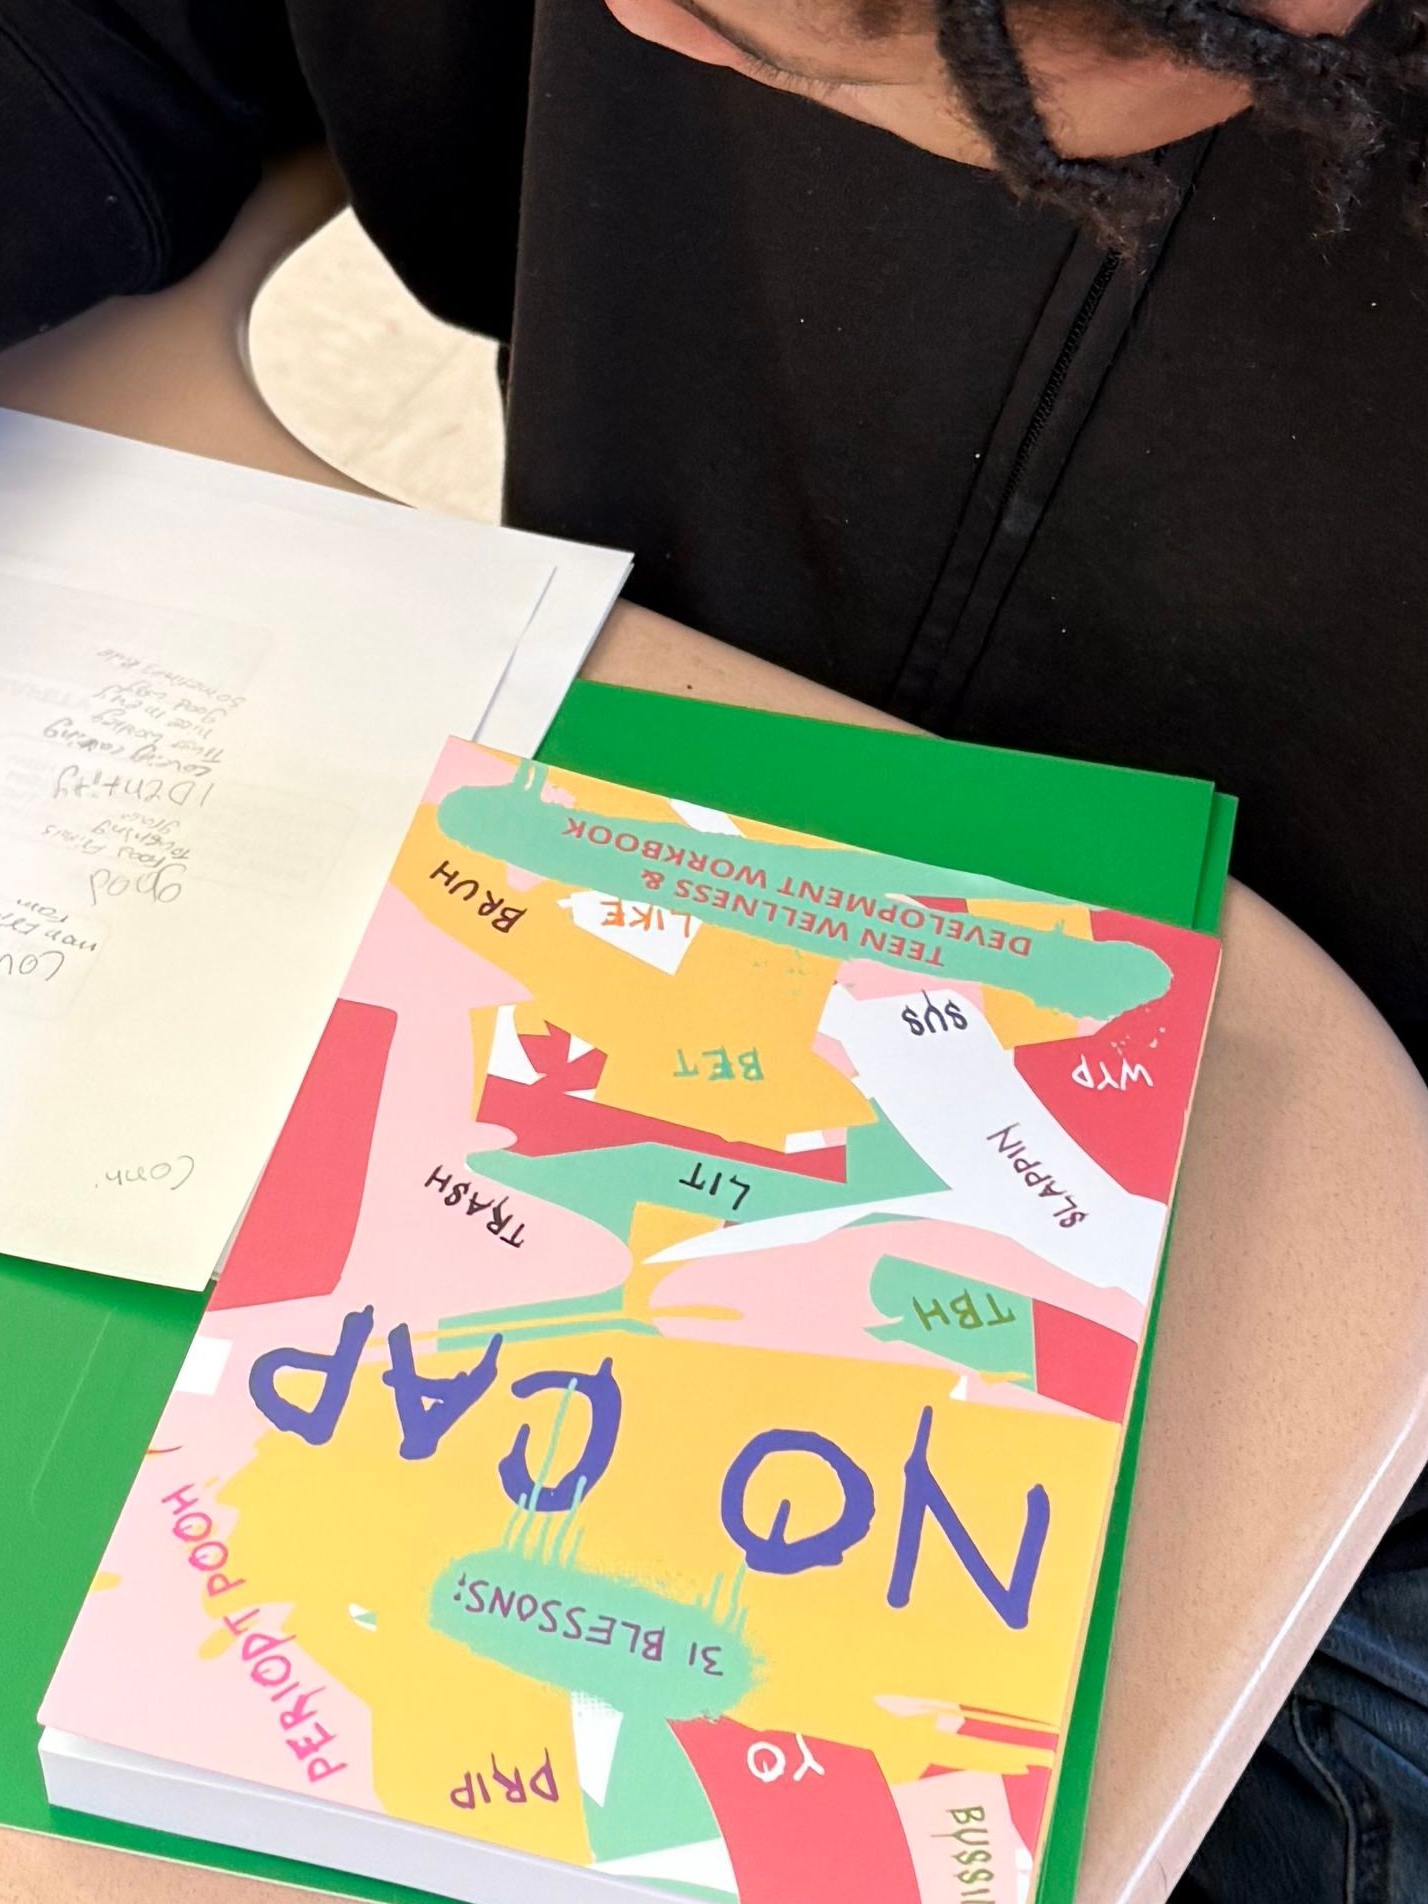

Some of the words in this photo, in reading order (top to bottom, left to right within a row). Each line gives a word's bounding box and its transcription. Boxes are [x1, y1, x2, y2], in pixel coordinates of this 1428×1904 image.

[560, 818, 766, 888] WORKBOOK
[641, 870, 665, 891] &
[429, 860, 527, 934] BRUH
[601, 901, 691, 939] LIKE
[675, 879, 847, 938] WELLNESS
[777, 876, 1032, 957] DEVELOPMENT
[859, 928, 944, 967] TEEN
[901, 990, 968, 1036] SUS
[673, 1047, 764, 1082] BET
[678, 1163, 750, 1210] LIT
[986, 1122, 1088, 1229] SLAPPIN
[424, 1166, 524, 1247] TRASH
[911, 1289, 1015, 1332] TBH
[248, 1305, 621, 1513] CAP
[161, 1483, 247, 1598] POOH
[721, 1406, 1051, 1631] NO
[688, 1640, 724, 1677] 31
[450, 1747, 559, 1809] DRIP
[746, 1732, 824, 1783] YO
